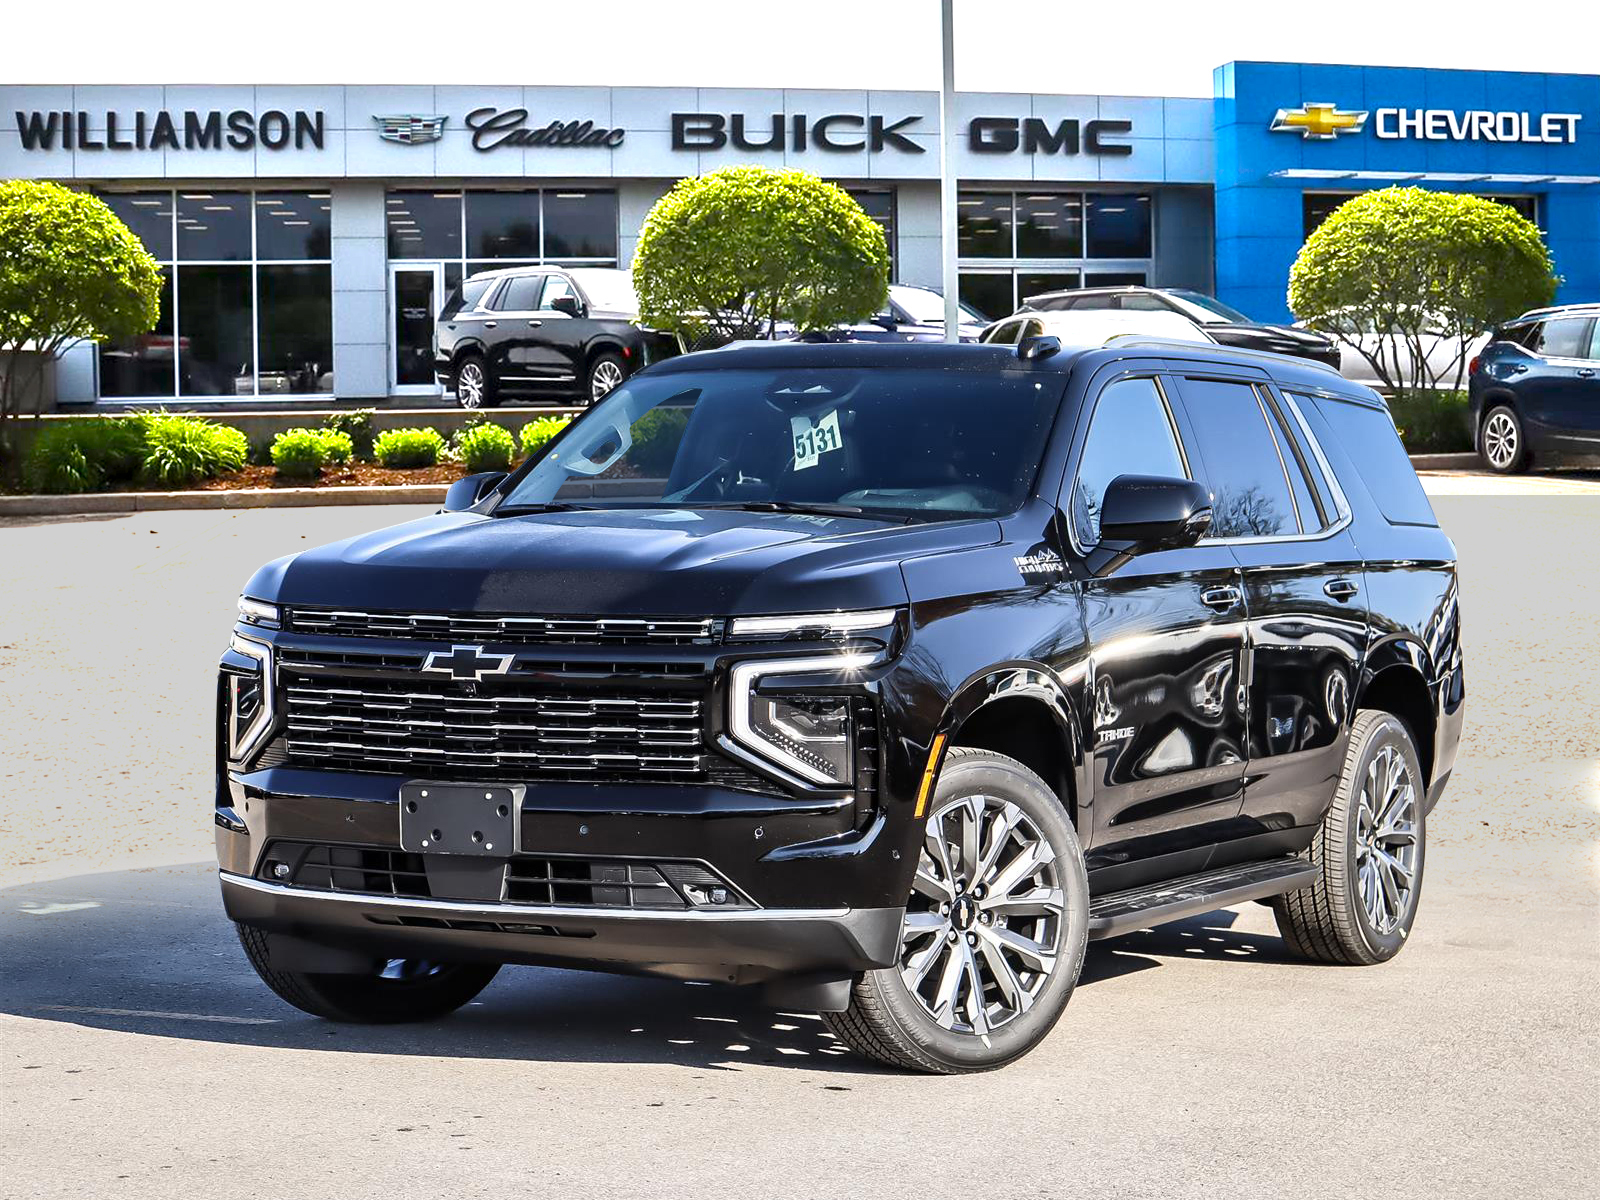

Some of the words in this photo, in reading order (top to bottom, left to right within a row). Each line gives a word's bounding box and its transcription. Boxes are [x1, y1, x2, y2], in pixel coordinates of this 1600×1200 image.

[15, 110, 323, 151] WILLIAMSON
[465, 107, 624, 151] Cadillac
[671, 113, 926, 153] BUICK
[969, 117, 1132, 155] GMC
[1375, 107, 1582, 143] CHEVROLET
[795, 424, 837, 459] 5131
[1097, 726, 1135, 742] TAHOE
